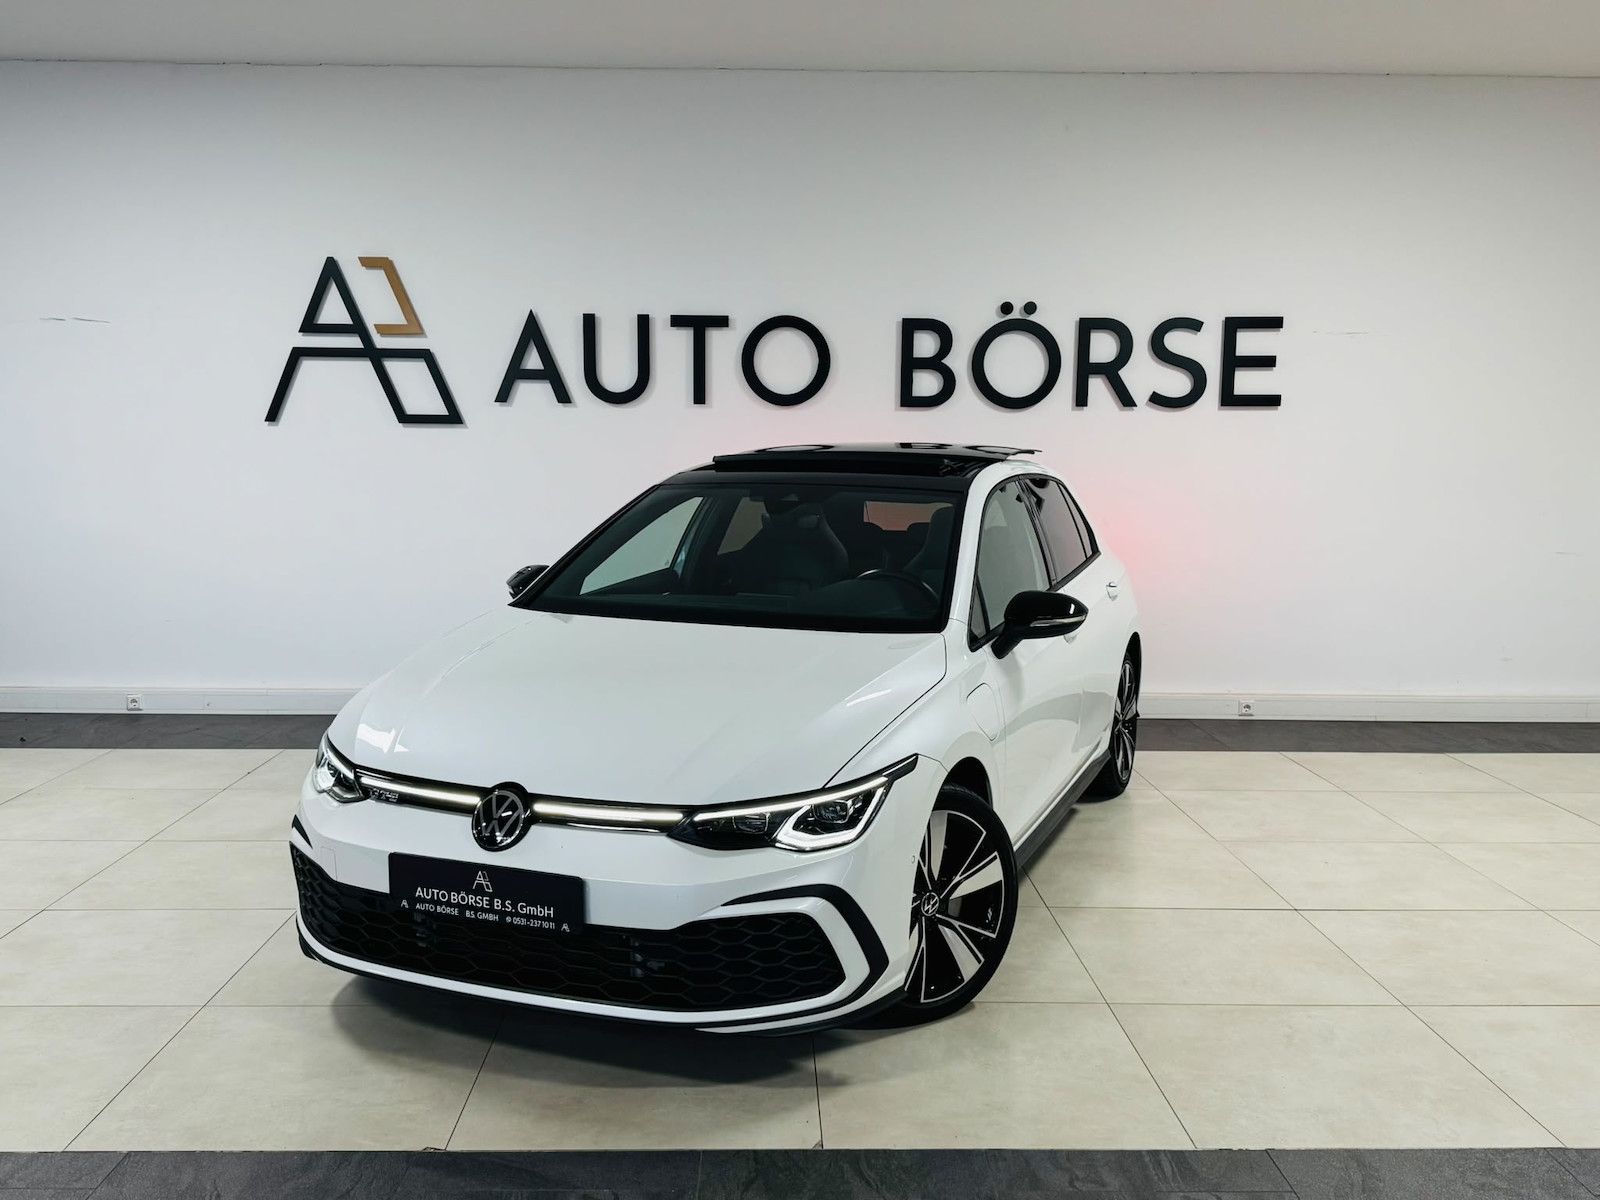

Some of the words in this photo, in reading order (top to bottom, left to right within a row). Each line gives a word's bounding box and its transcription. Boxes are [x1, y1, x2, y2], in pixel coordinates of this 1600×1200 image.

[494, 309, 832, 407] AUTO
[899, 301, 1285, 410] BÖRSE
[415, 887, 449, 902] AUTO
[450, 891, 491, 909] BÖRSE
[493, 898, 515, 912] B.S.
[517, 902, 554, 918] GmbH
[415, 903, 435, 912] AUTO
[436, 905, 460, 916] BÖRSE
[477, 912, 499, 922] GMBH
